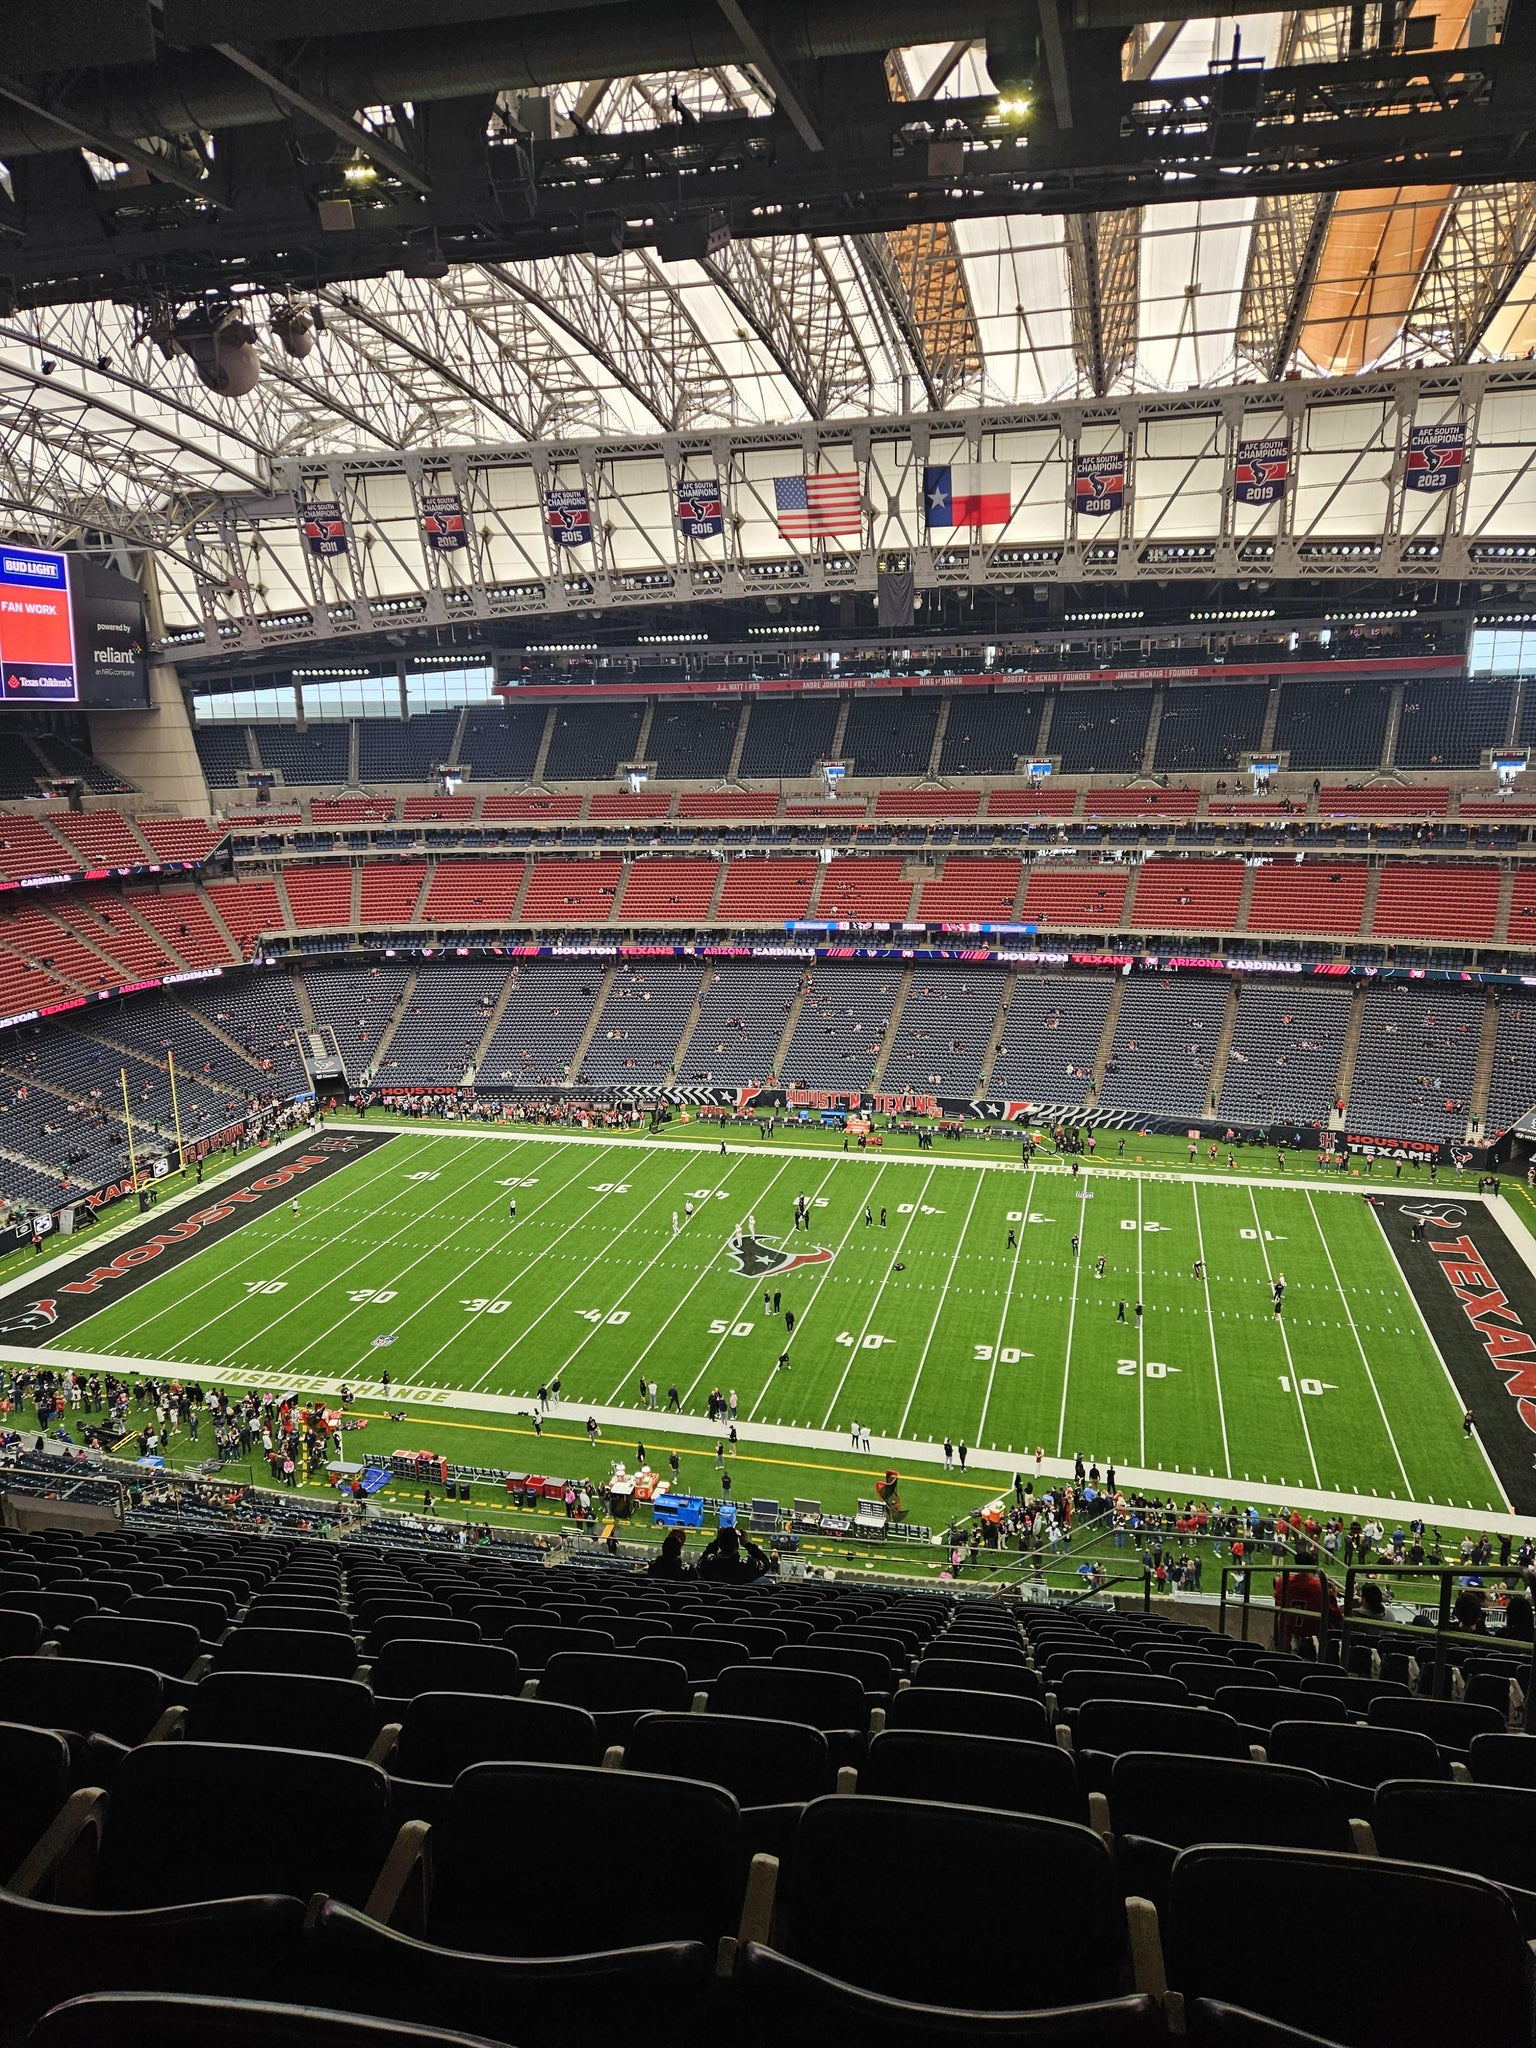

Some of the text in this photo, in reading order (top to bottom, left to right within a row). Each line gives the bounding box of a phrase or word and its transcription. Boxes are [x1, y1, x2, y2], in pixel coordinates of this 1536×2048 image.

[1434, 427, 1460, 435] SOUTH
[1260, 441, 1283, 449] SOUTH
[1412, 434, 1464, 445] CHAMPIONS
[1096, 455, 1118, 463] SOUTH
[1239, 448, 1288, 458] CHAMPIONS
[1077, 462, 1123, 473] CHAMPIONS
[1417, 474, 1447, 487] 2023
[679, 488, 718, 498] CHAMPIONS
[1246, 487, 1273, 499] 2019
[423, 503, 459, 512] CHAMPIONS
[548, 497, 586, 506] CHAMPIONS
[1086, 499, 1111, 512] 2018
[691, 522, 713, 534] 2016
[437, 536, 458, 547] 2012
[561, 531, 583, 542] 2015
[320, 541, 337, 552] 2011
[5, 560, 57, 576] BUD LIGHT
[1, 601, 57, 615] FAN WORK
[97, 623, 131, 633] powered by
[94, 647, 135, 664] reliant
[1062, 673, 1091, 681] FOUNDER
[1115, 671, 1138, 679] JANICE
[1169, 669, 1198, 677] FOUNDER
[19, 676, 38, 687] Texas
[941, 677, 963, 685] HONOR
[21, 874, 72, 888] CARDINALS
[552, 947, 617, 955] HOUSTON
[619, 947, 674, 955] TEXANS
[753, 948, 816, 956] CARDINALS
[998, 952, 1302, 972] HOUSTON TEXANS ARIZONA CARDINALS
[39, 998, 87, 1016] TEXANS
[119, 979, 162, 994] ARIZONA
[162, 968, 223, 984] CARDINALS
[382, 1087, 458, 1095] HOUSTON
[1347, 1134, 1440, 1152] HOUSTON
[1093, 1169, 1182, 1180] CHANGE
[58, 1155, 330, 1295] HOUSTON
[93, 1215, 150, 1243] TAKES
[153, 1197, 184, 1213] ALL
[247, 1281, 288, 1294] 10
[349, 1289, 399, 1303] 20
[464, 1299, 512, 1314] 30
[582, 1309, 632, 1325] 40
[707, 1319, 755, 1337] 50
[835, 1331, 885, 1350] 40
[1428, 1235, 1536, 1435] TEXAN
[973, 1344, 1021, 1364] 30
[1116, 1360, 1168, 1379] 20
[214, 1370, 451, 1404] INSPIRE CHANGE
[1277, 1376, 1326, 1396] 10
